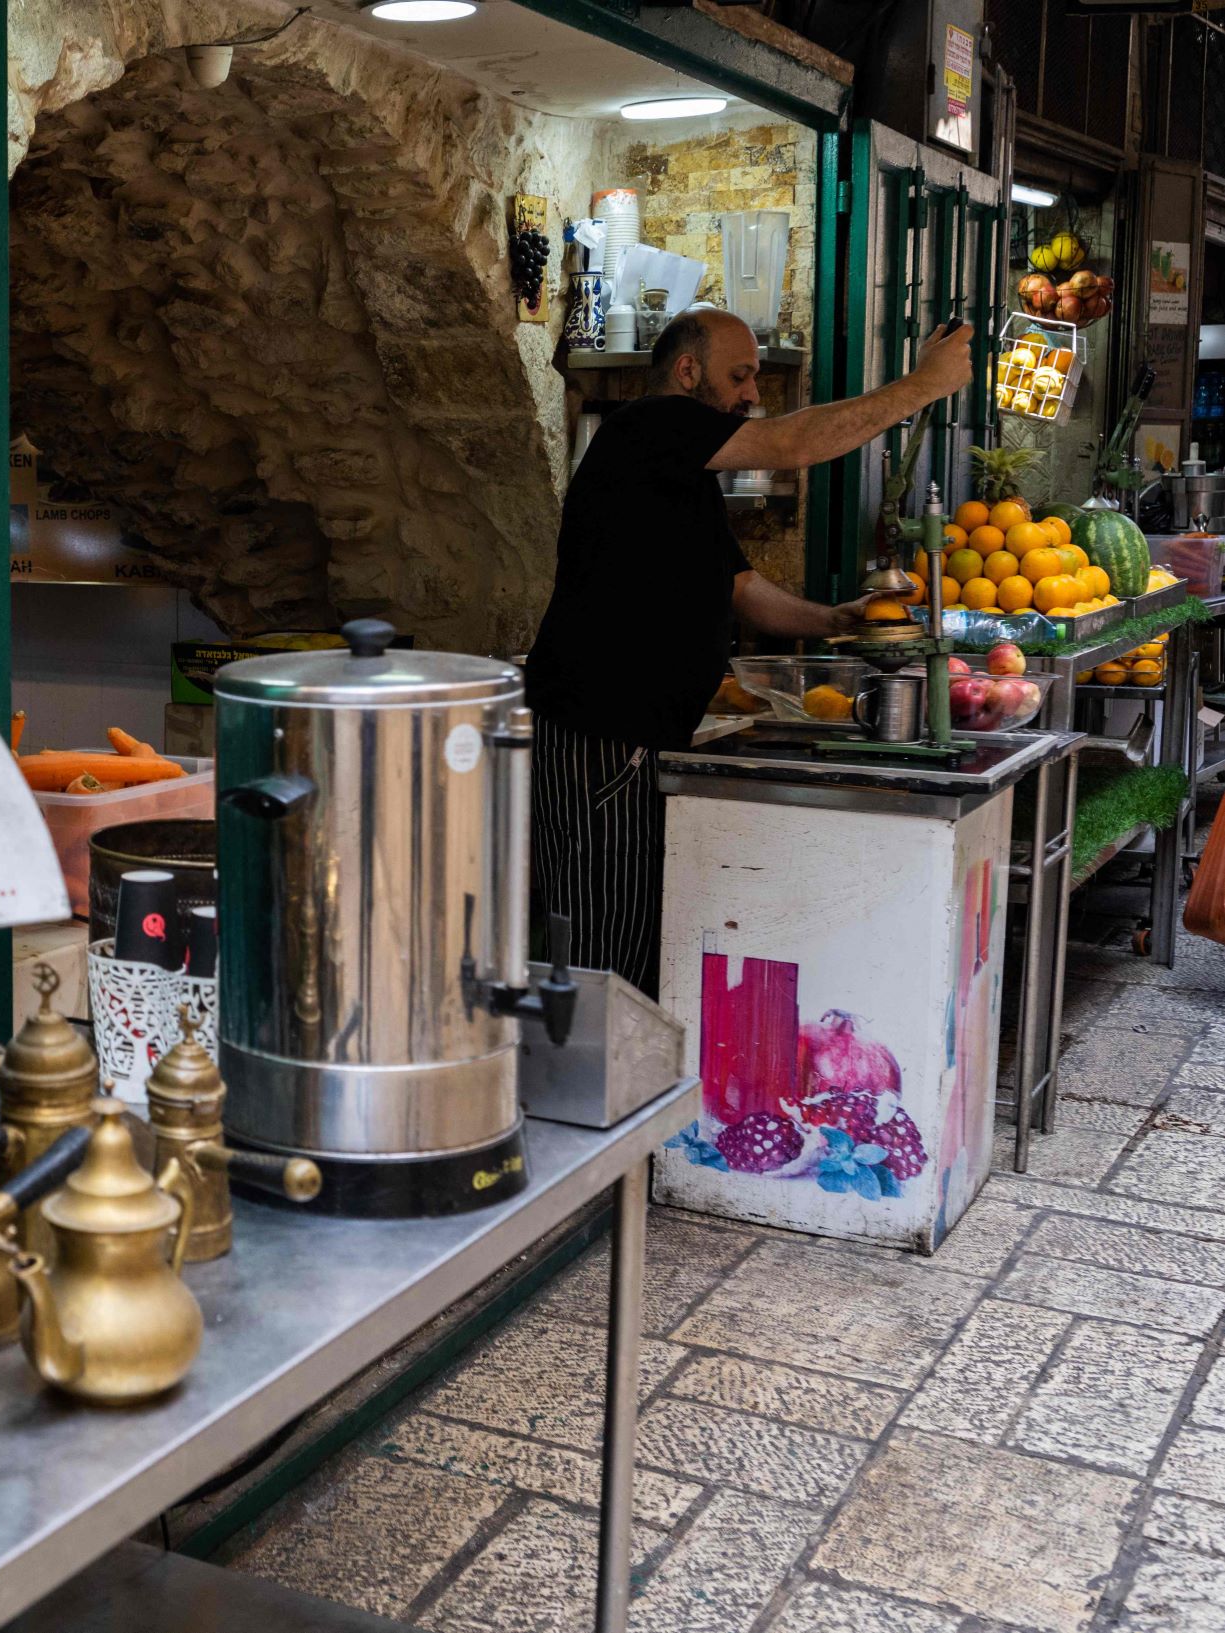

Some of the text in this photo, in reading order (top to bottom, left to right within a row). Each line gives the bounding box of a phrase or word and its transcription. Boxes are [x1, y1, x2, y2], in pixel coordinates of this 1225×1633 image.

[36, 509, 111, 521] LAMB CHOPS
[114, 563, 161, 579] KAB
